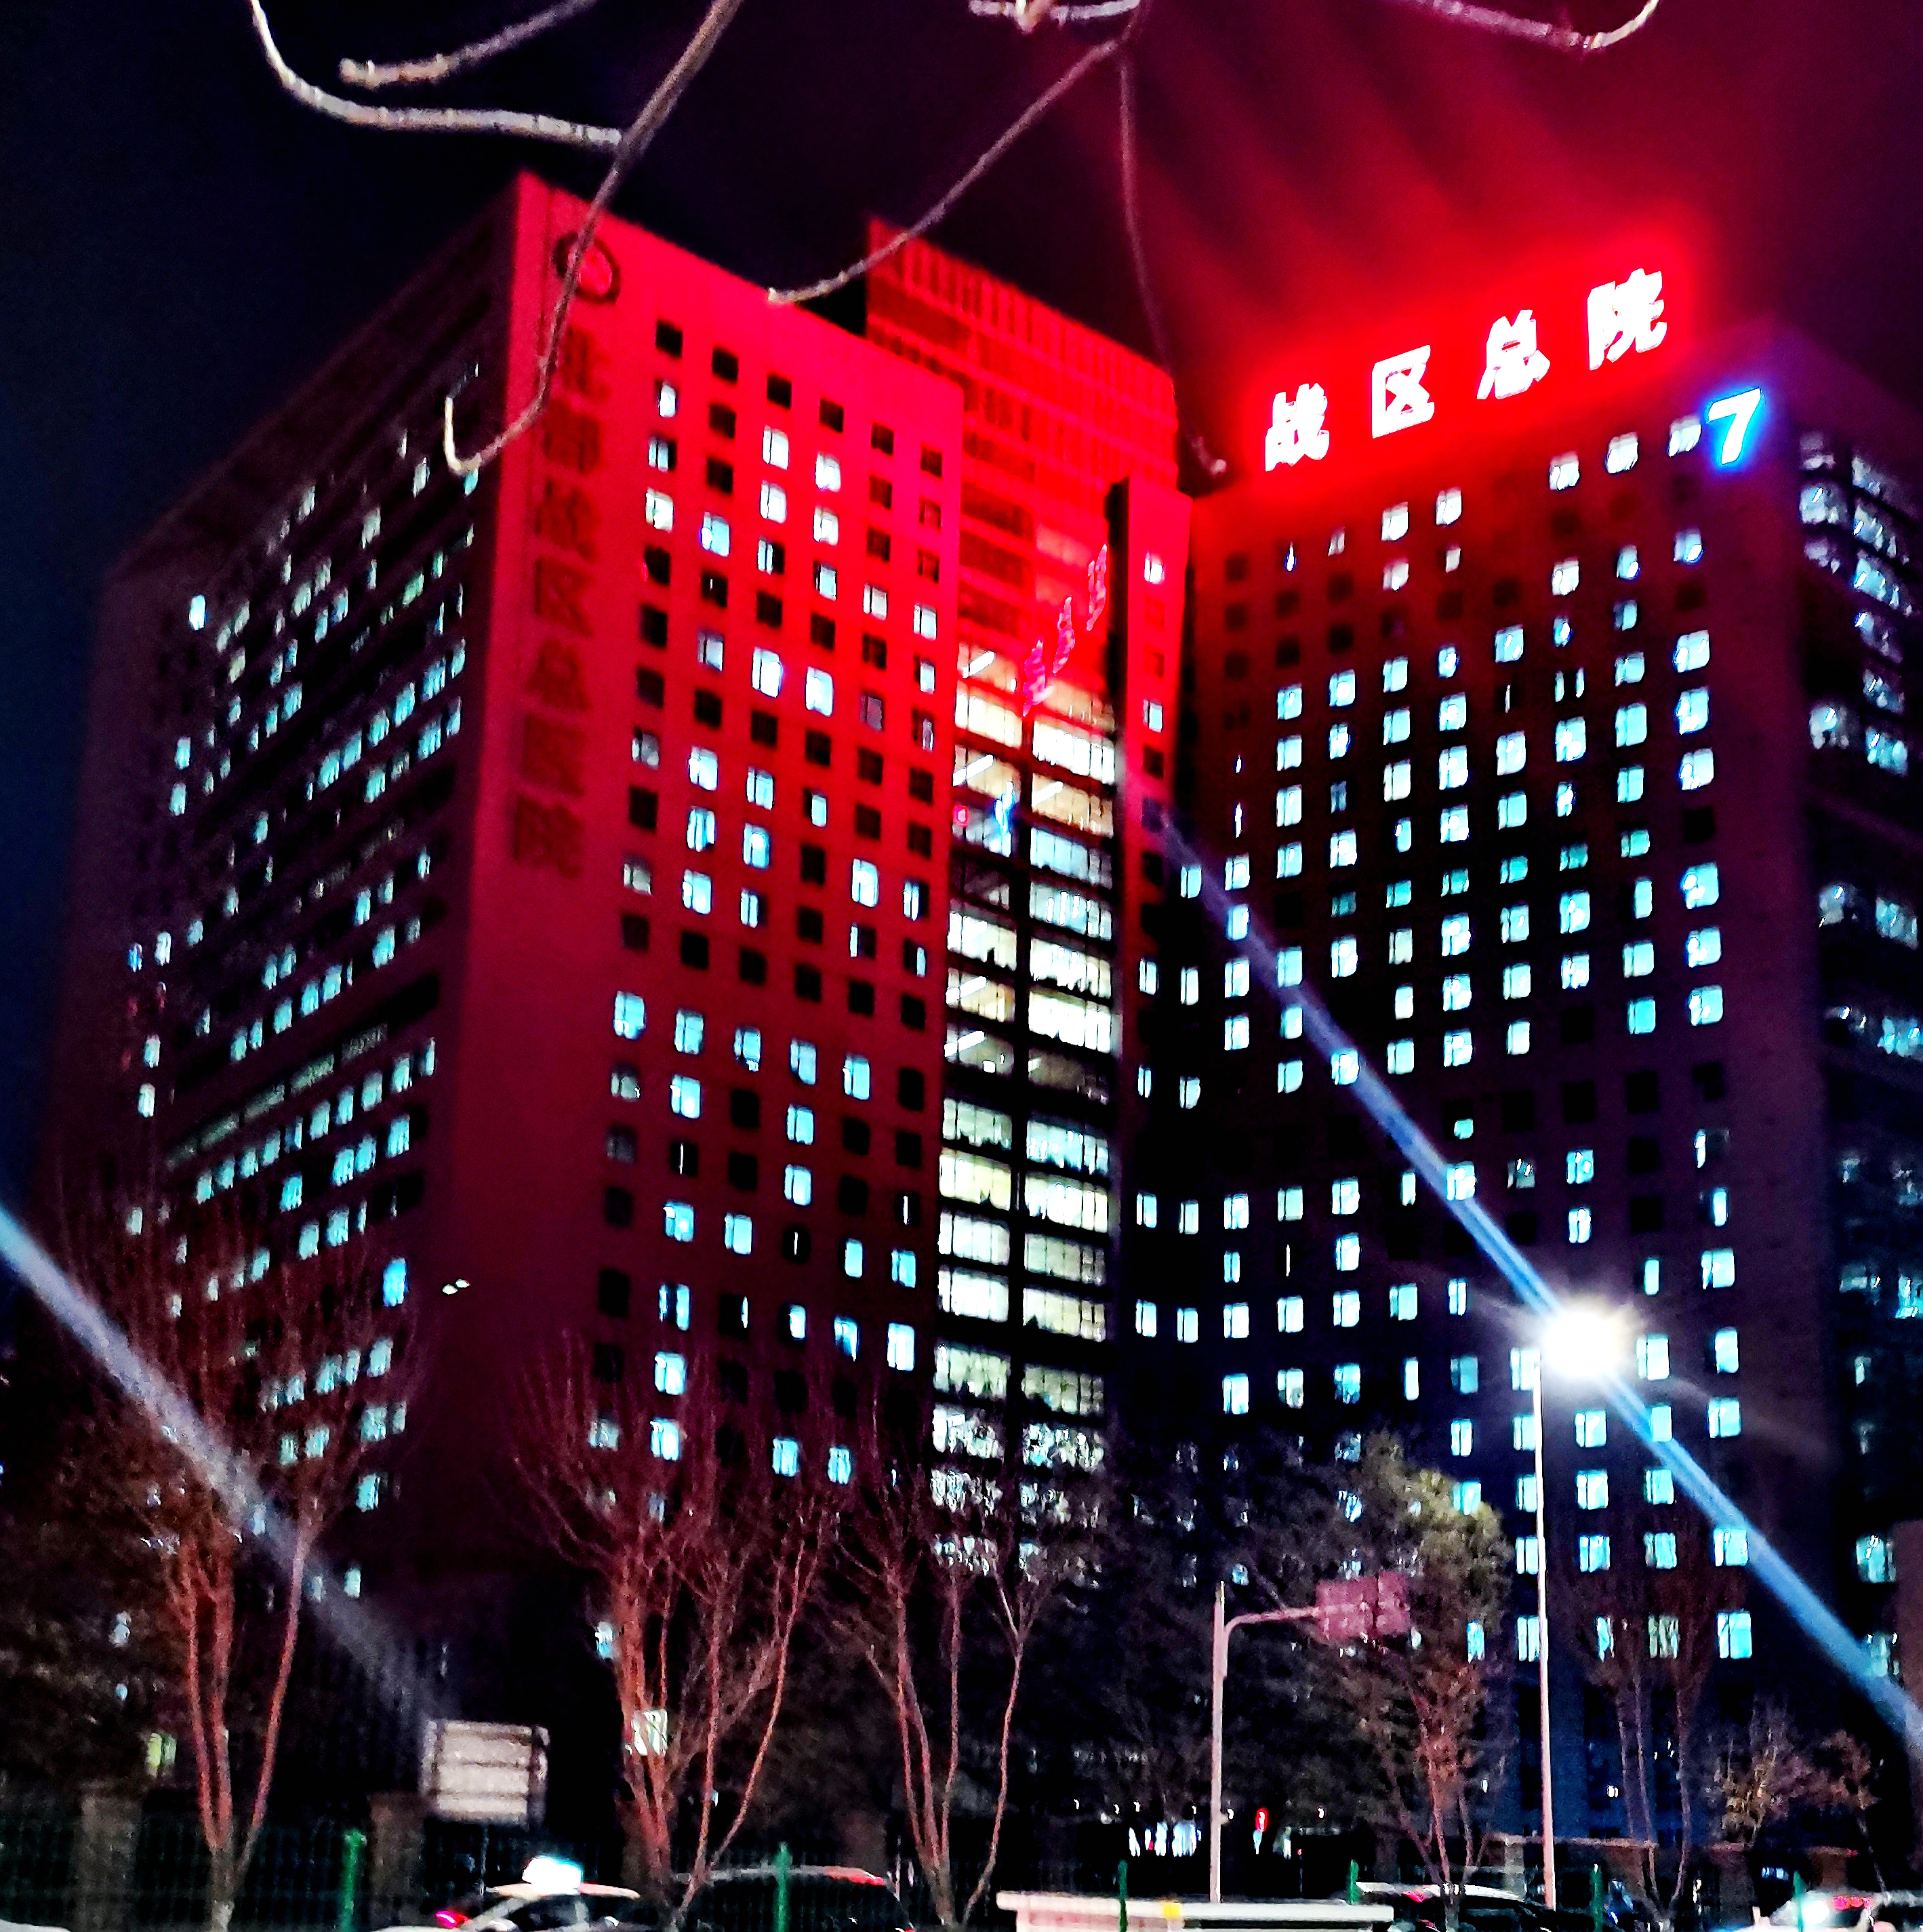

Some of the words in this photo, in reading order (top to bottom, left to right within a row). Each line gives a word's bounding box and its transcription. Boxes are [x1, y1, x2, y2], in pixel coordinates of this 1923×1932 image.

[1265, 268, 1667, 472] 战区总院
[1707, 388, 1762, 466] 7
